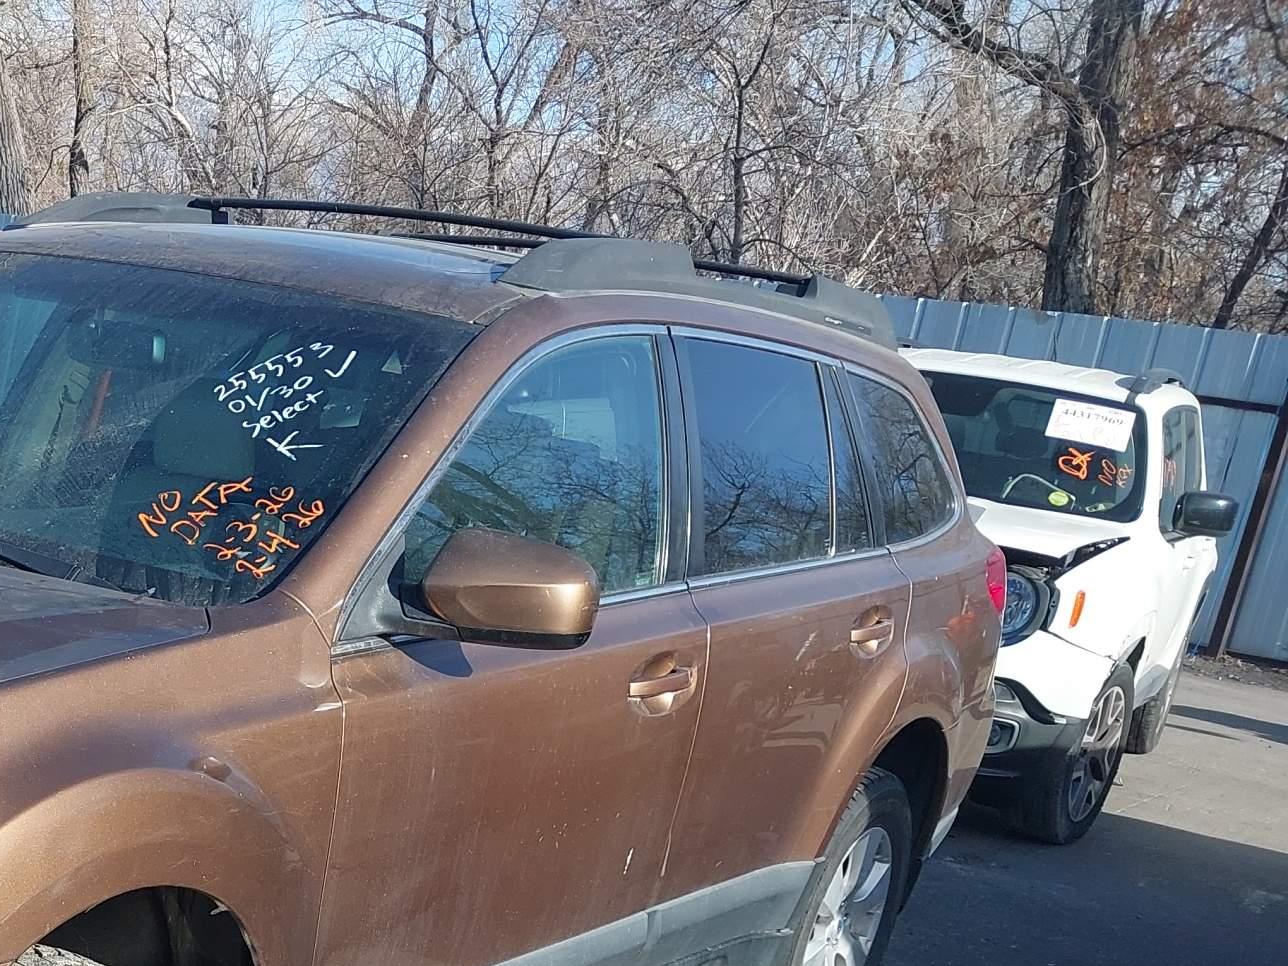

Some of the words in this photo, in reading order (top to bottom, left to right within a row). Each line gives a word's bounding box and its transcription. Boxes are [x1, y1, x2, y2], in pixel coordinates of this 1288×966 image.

[213, 342, 334, 401] 255553
[228, 375, 314, 413] 01/30
[138, 490, 182, 537] NO
[170, 476, 254, 545] DATA
[203, 486, 296, 560] 2-3-26
